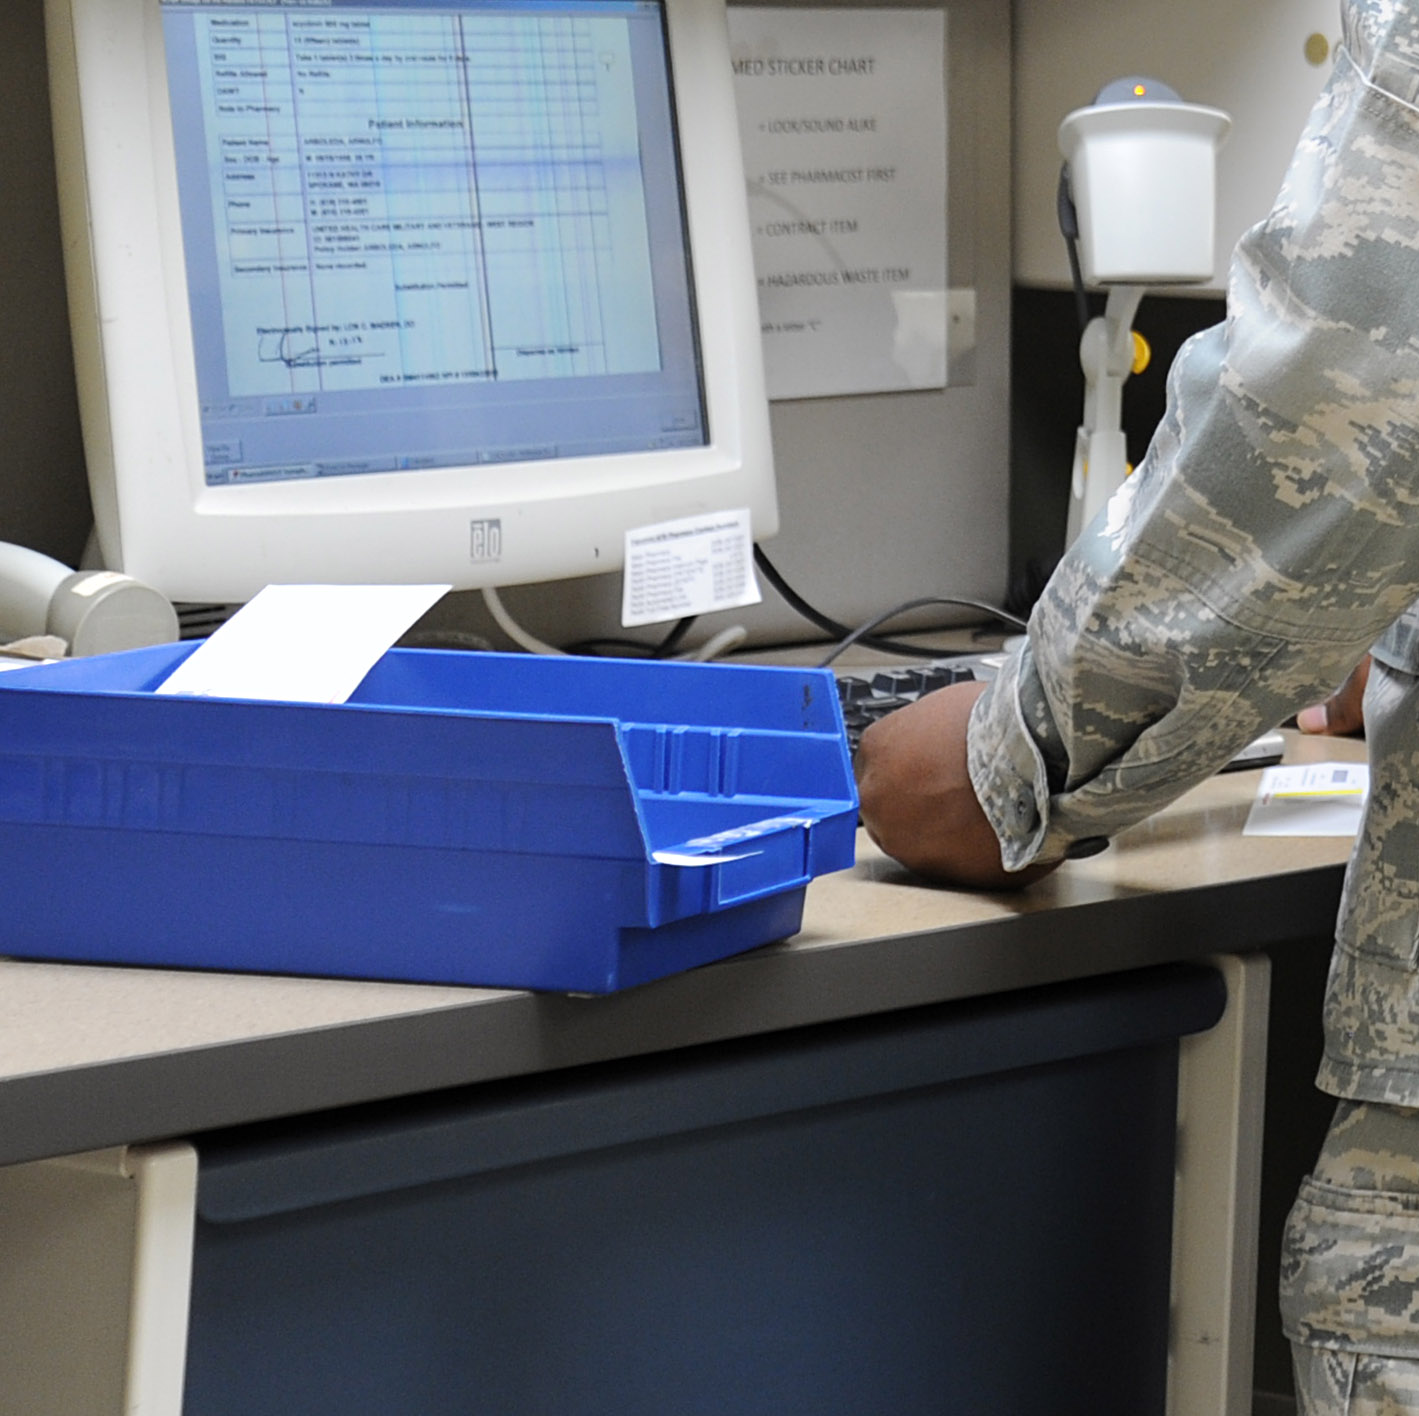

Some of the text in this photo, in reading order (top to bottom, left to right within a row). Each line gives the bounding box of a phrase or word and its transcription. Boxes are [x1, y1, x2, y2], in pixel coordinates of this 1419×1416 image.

[732, 58, 876, 75] MED STICKER CHART
[368, 119, 463, 129] Patient Information
[767, 118, 843, 134] LOOK/SOUND
[847, 117, 877, 132] ALIKE
[768, 170, 788, 185] SEE
[791, 168, 863, 184] PHARMACIST
[867, 166, 896, 182] FIRST
[766, 220, 827, 237] CONTRACT
[830, 219, 858, 233] ITEM
[767, 271, 839, 287] HAZARDOUS
[840, 269, 879, 283] WASTE
[882, 267, 909, 281] ITEM
